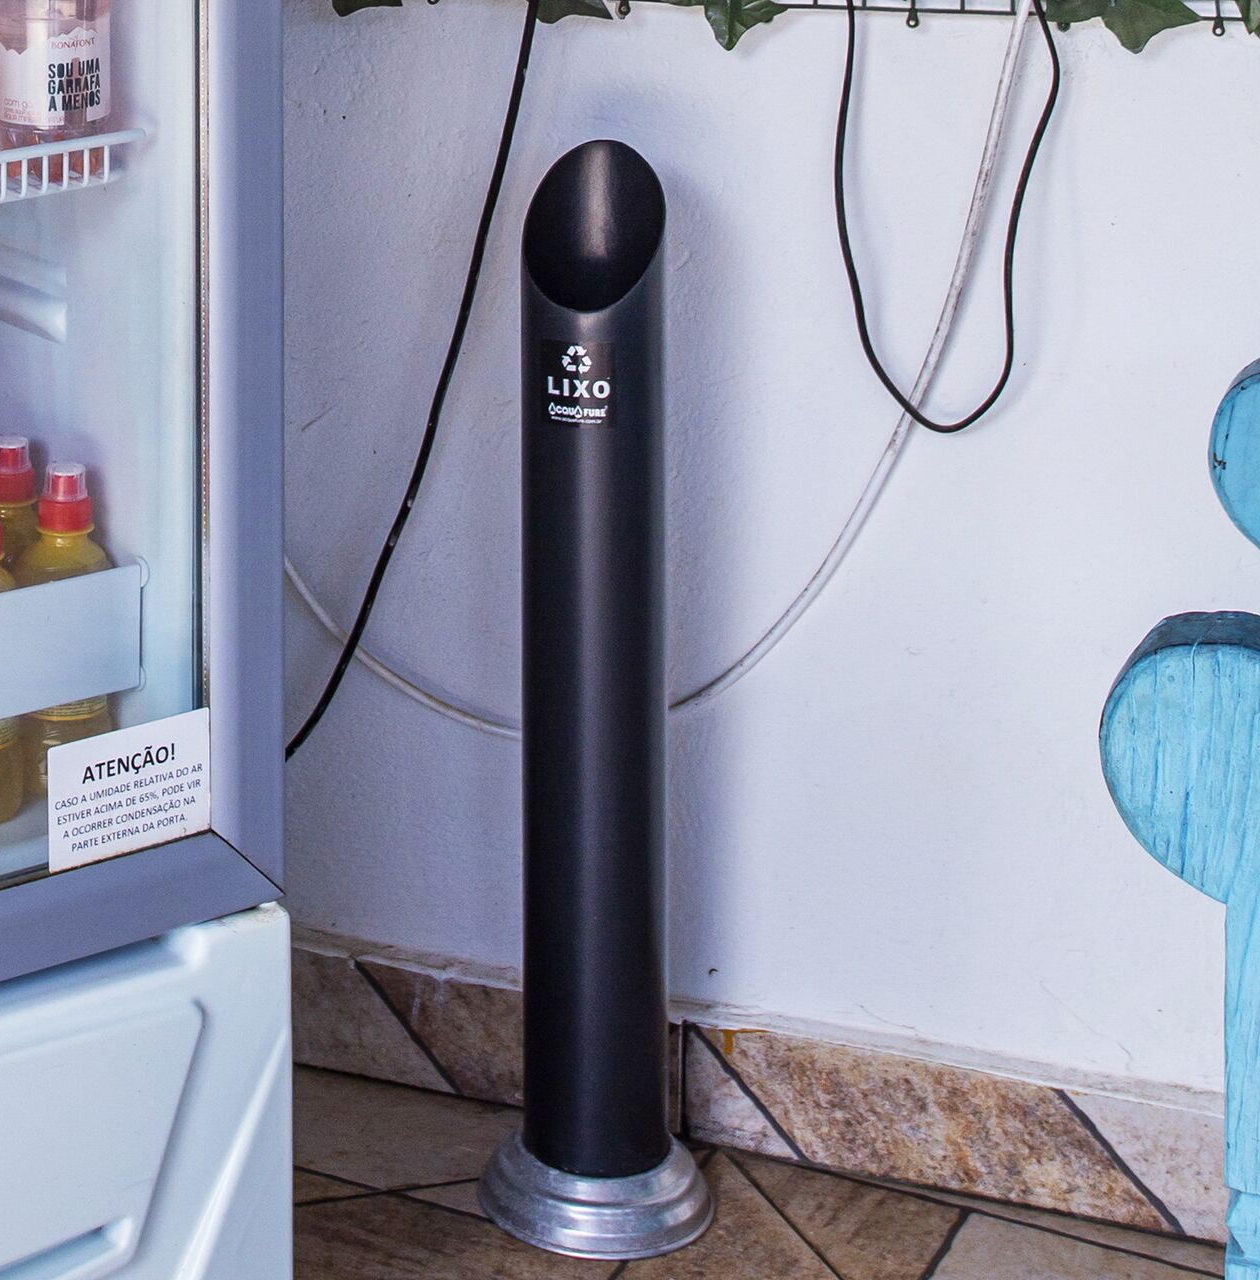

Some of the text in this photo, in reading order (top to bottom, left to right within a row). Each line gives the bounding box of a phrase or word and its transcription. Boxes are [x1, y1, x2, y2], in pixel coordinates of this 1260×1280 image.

[51, 37, 95, 50] BONAFONT
[47, 57, 100, 79] SOU UMA
[47, 73, 100, 95] GARRAFA
[48, 89, 101, 112] A MENOS
[547, 375, 611, 399] LIXO
[82, 743, 175, 784] ATENÇÃO!
[54, 762, 203, 810] CASO A UMIDADE RELATIVA DO AR
[57, 778, 201, 826] ESTIVER ACIMA DE 65%, PODE VIR
[63, 795, 196, 840] A OCORRER CONDENSAÇÃO NA
[71, 813, 188, 853] PARTE EXTERNA DA PORTA.
